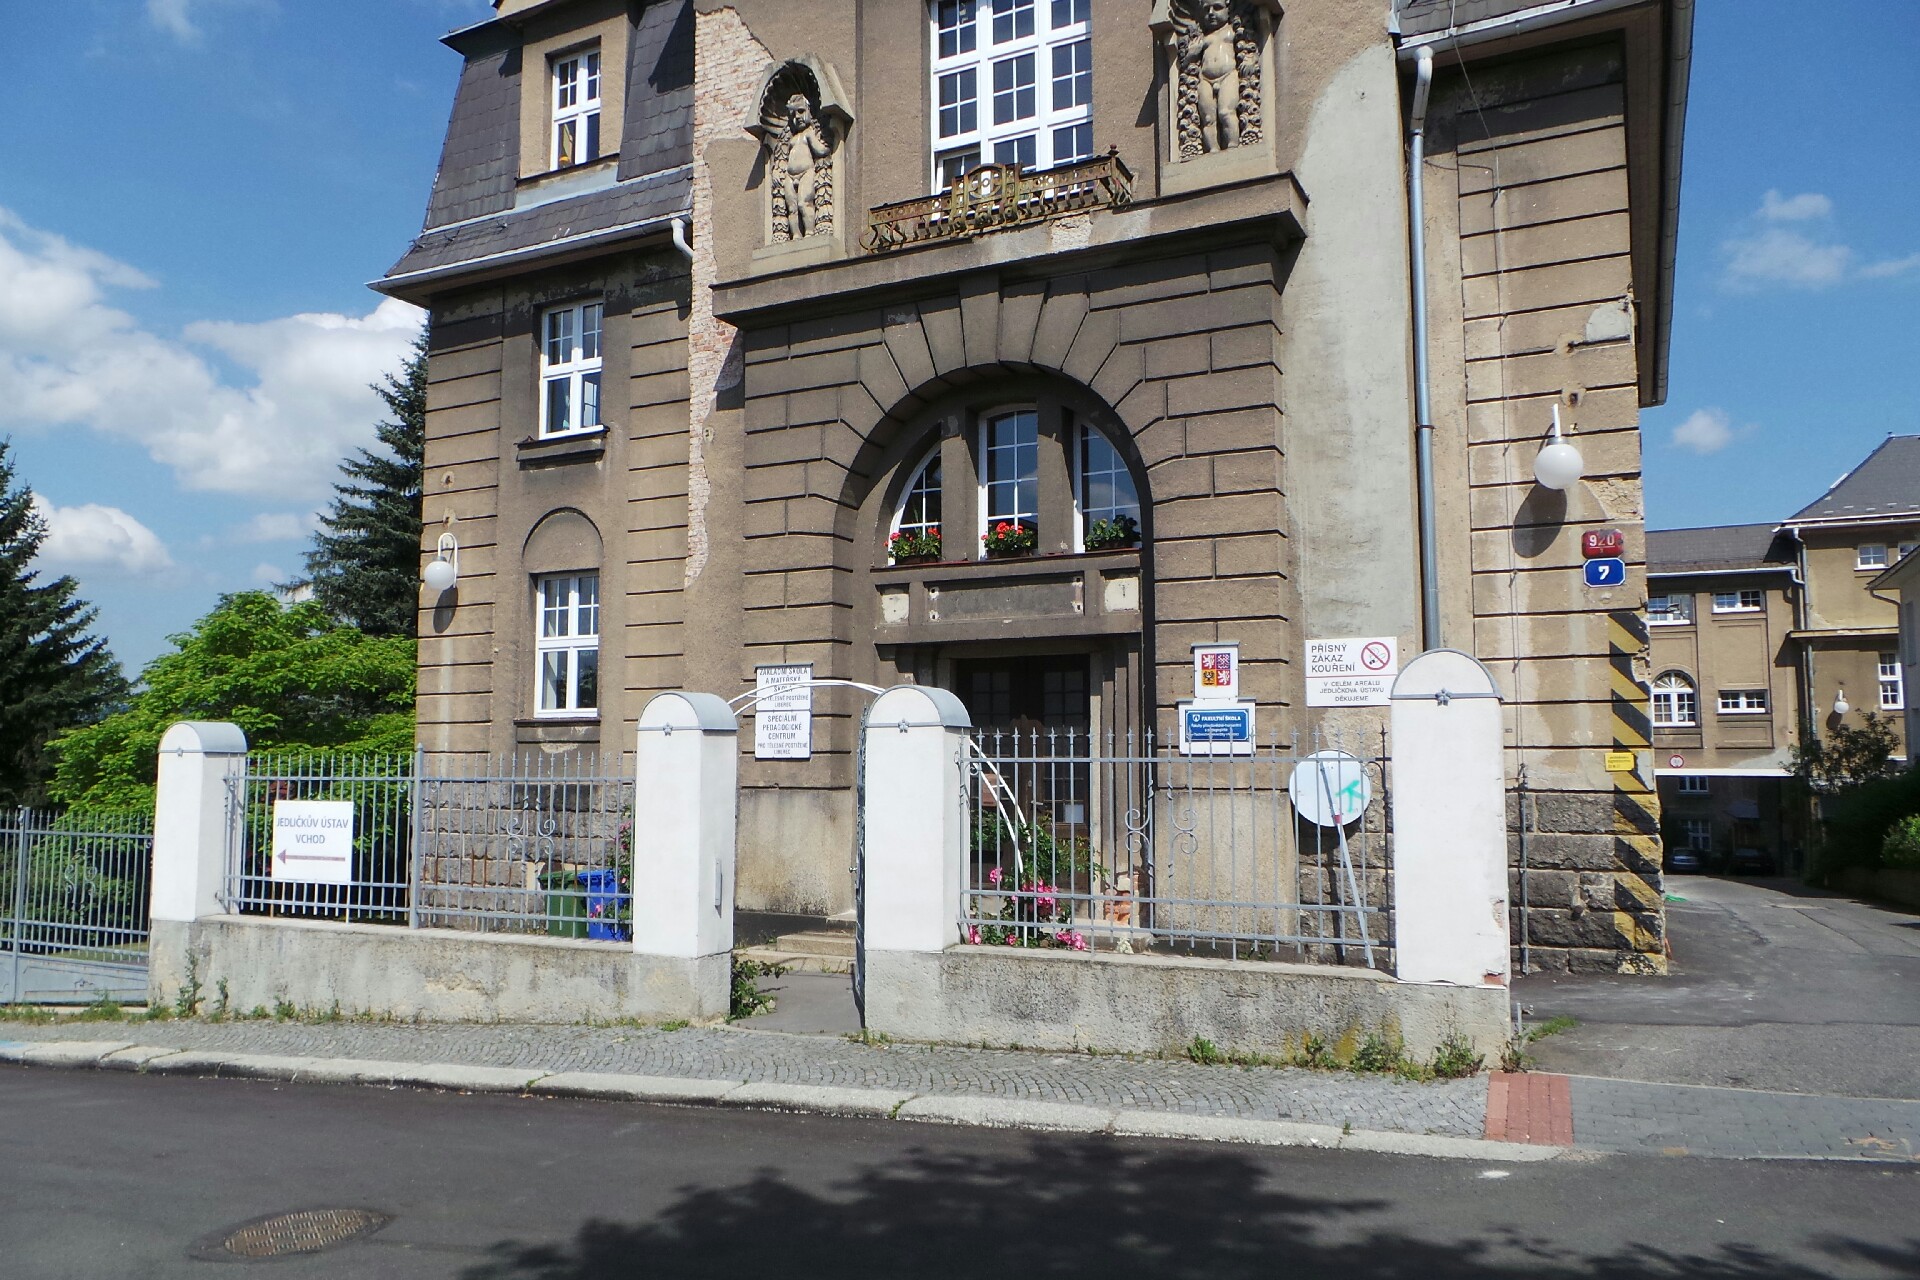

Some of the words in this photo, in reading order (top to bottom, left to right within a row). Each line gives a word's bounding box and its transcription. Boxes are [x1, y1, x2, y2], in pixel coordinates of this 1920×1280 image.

[1589, 534, 1615, 547] 920
[1598, 565, 1610, 580] 7
[1311, 643, 1347, 653] PŘÍSNÝ
[1311, 653, 1343, 663] ZÁKAZ
[1311, 662, 1355, 673] KOUŘENÍ
[277, 815, 318, 828] JEDLIČKŮV
[320, 816, 348, 828] ÚSTAV
[296, 834, 325, 844] VCHOD
